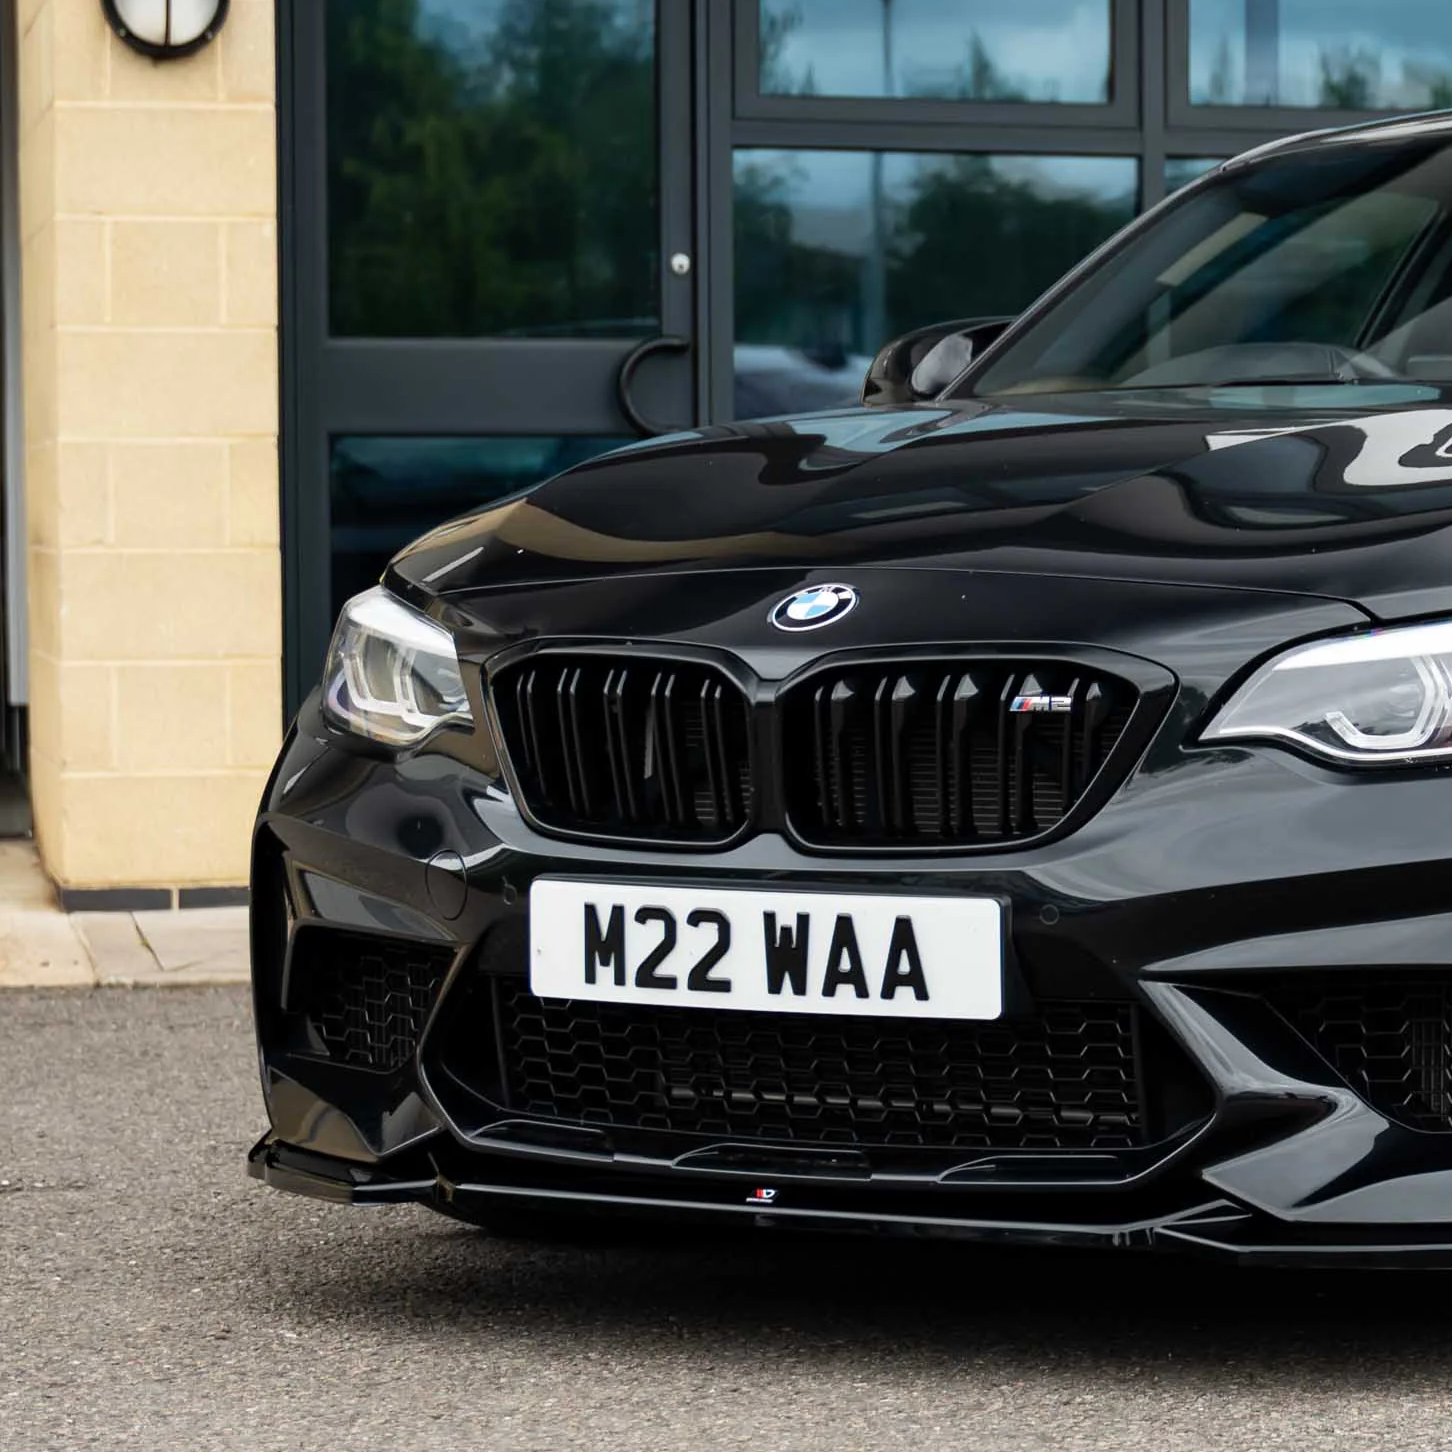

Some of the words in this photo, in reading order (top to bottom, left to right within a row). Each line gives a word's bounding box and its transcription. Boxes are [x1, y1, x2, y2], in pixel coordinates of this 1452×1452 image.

[1026, 695, 1072, 712] M2
[584, 902, 733, 993] M22
[762, 910, 931, 1002] WAA
